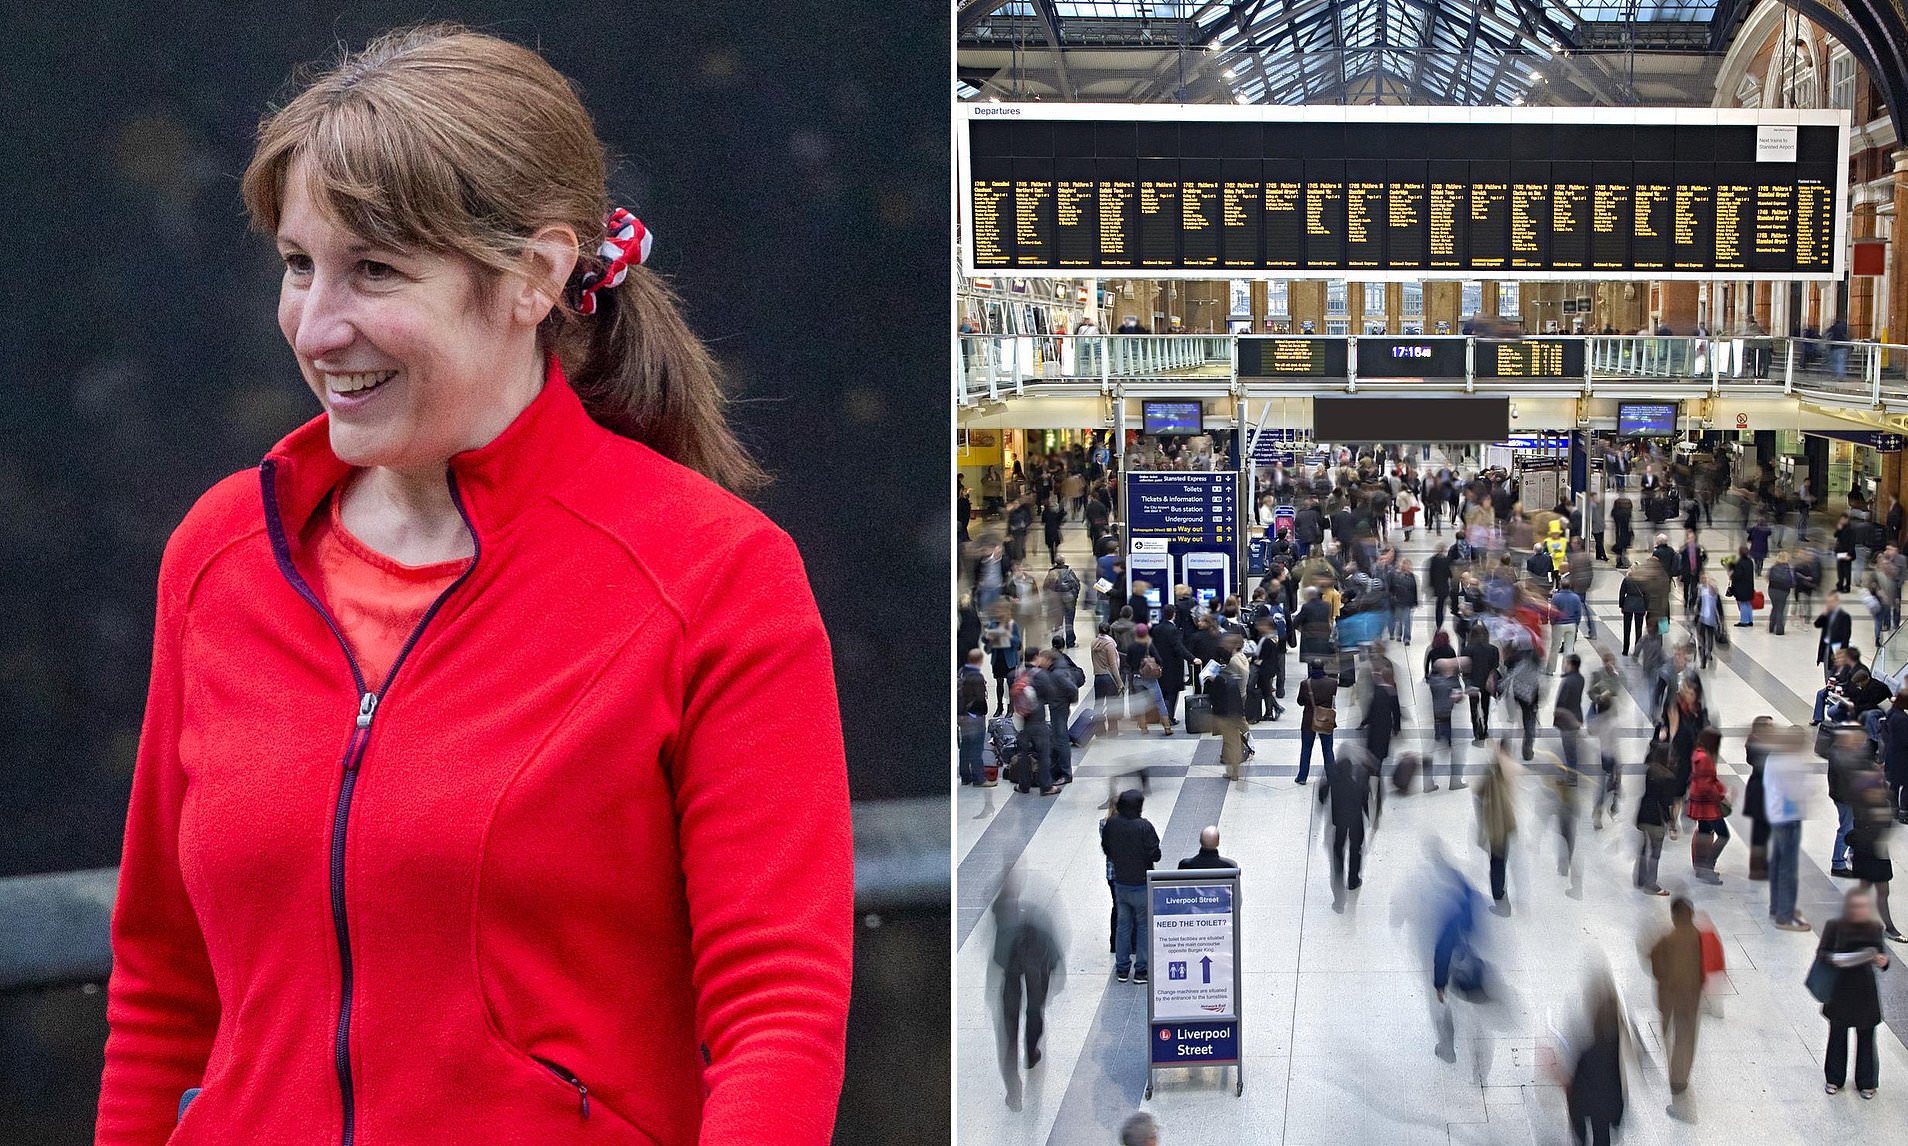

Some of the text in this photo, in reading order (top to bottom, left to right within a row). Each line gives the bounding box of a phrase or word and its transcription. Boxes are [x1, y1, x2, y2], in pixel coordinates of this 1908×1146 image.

[974, 106, 1021, 116] Departures
[1177, 1027, 1230, 1041] Liverpool
[1177, 1044, 1213, 1056] Street
